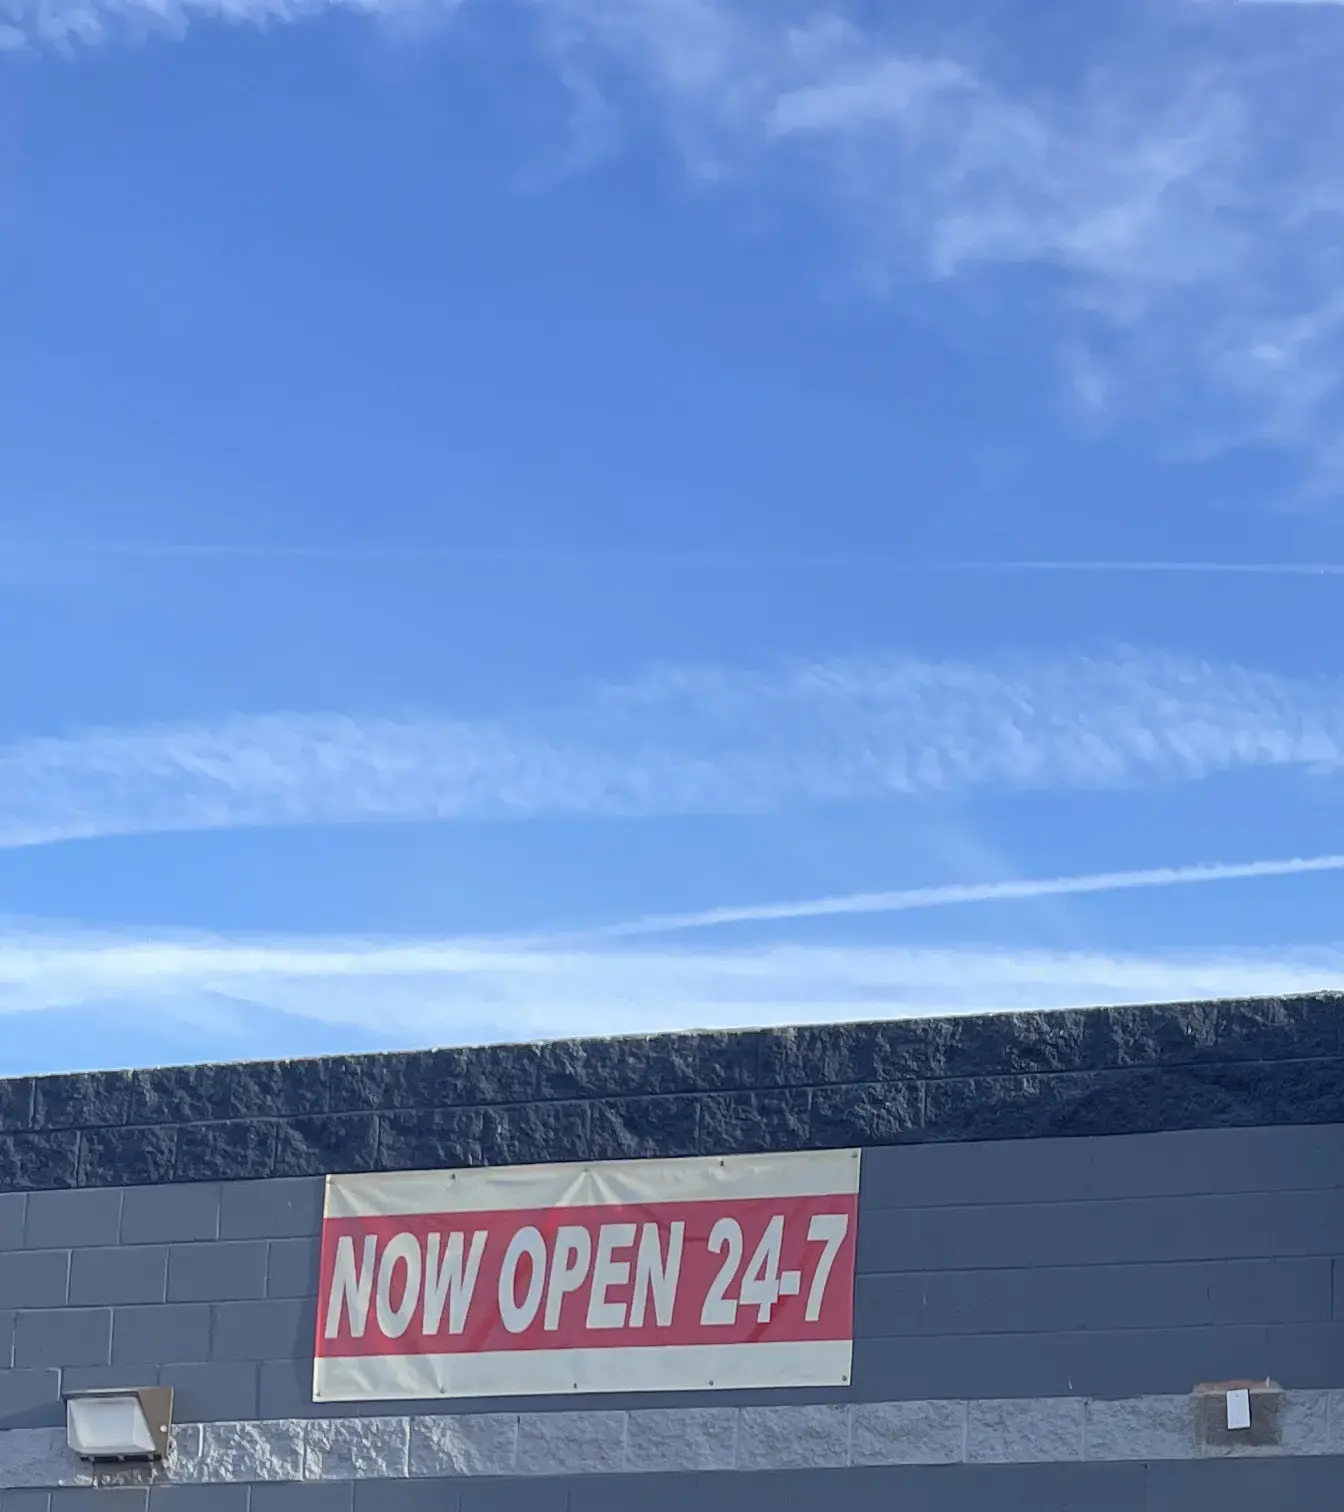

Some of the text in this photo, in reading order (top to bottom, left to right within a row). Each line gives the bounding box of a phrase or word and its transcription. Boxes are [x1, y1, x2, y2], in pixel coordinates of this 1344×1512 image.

[324, 1213, 849, 1339] NOW OPEN 24-7
